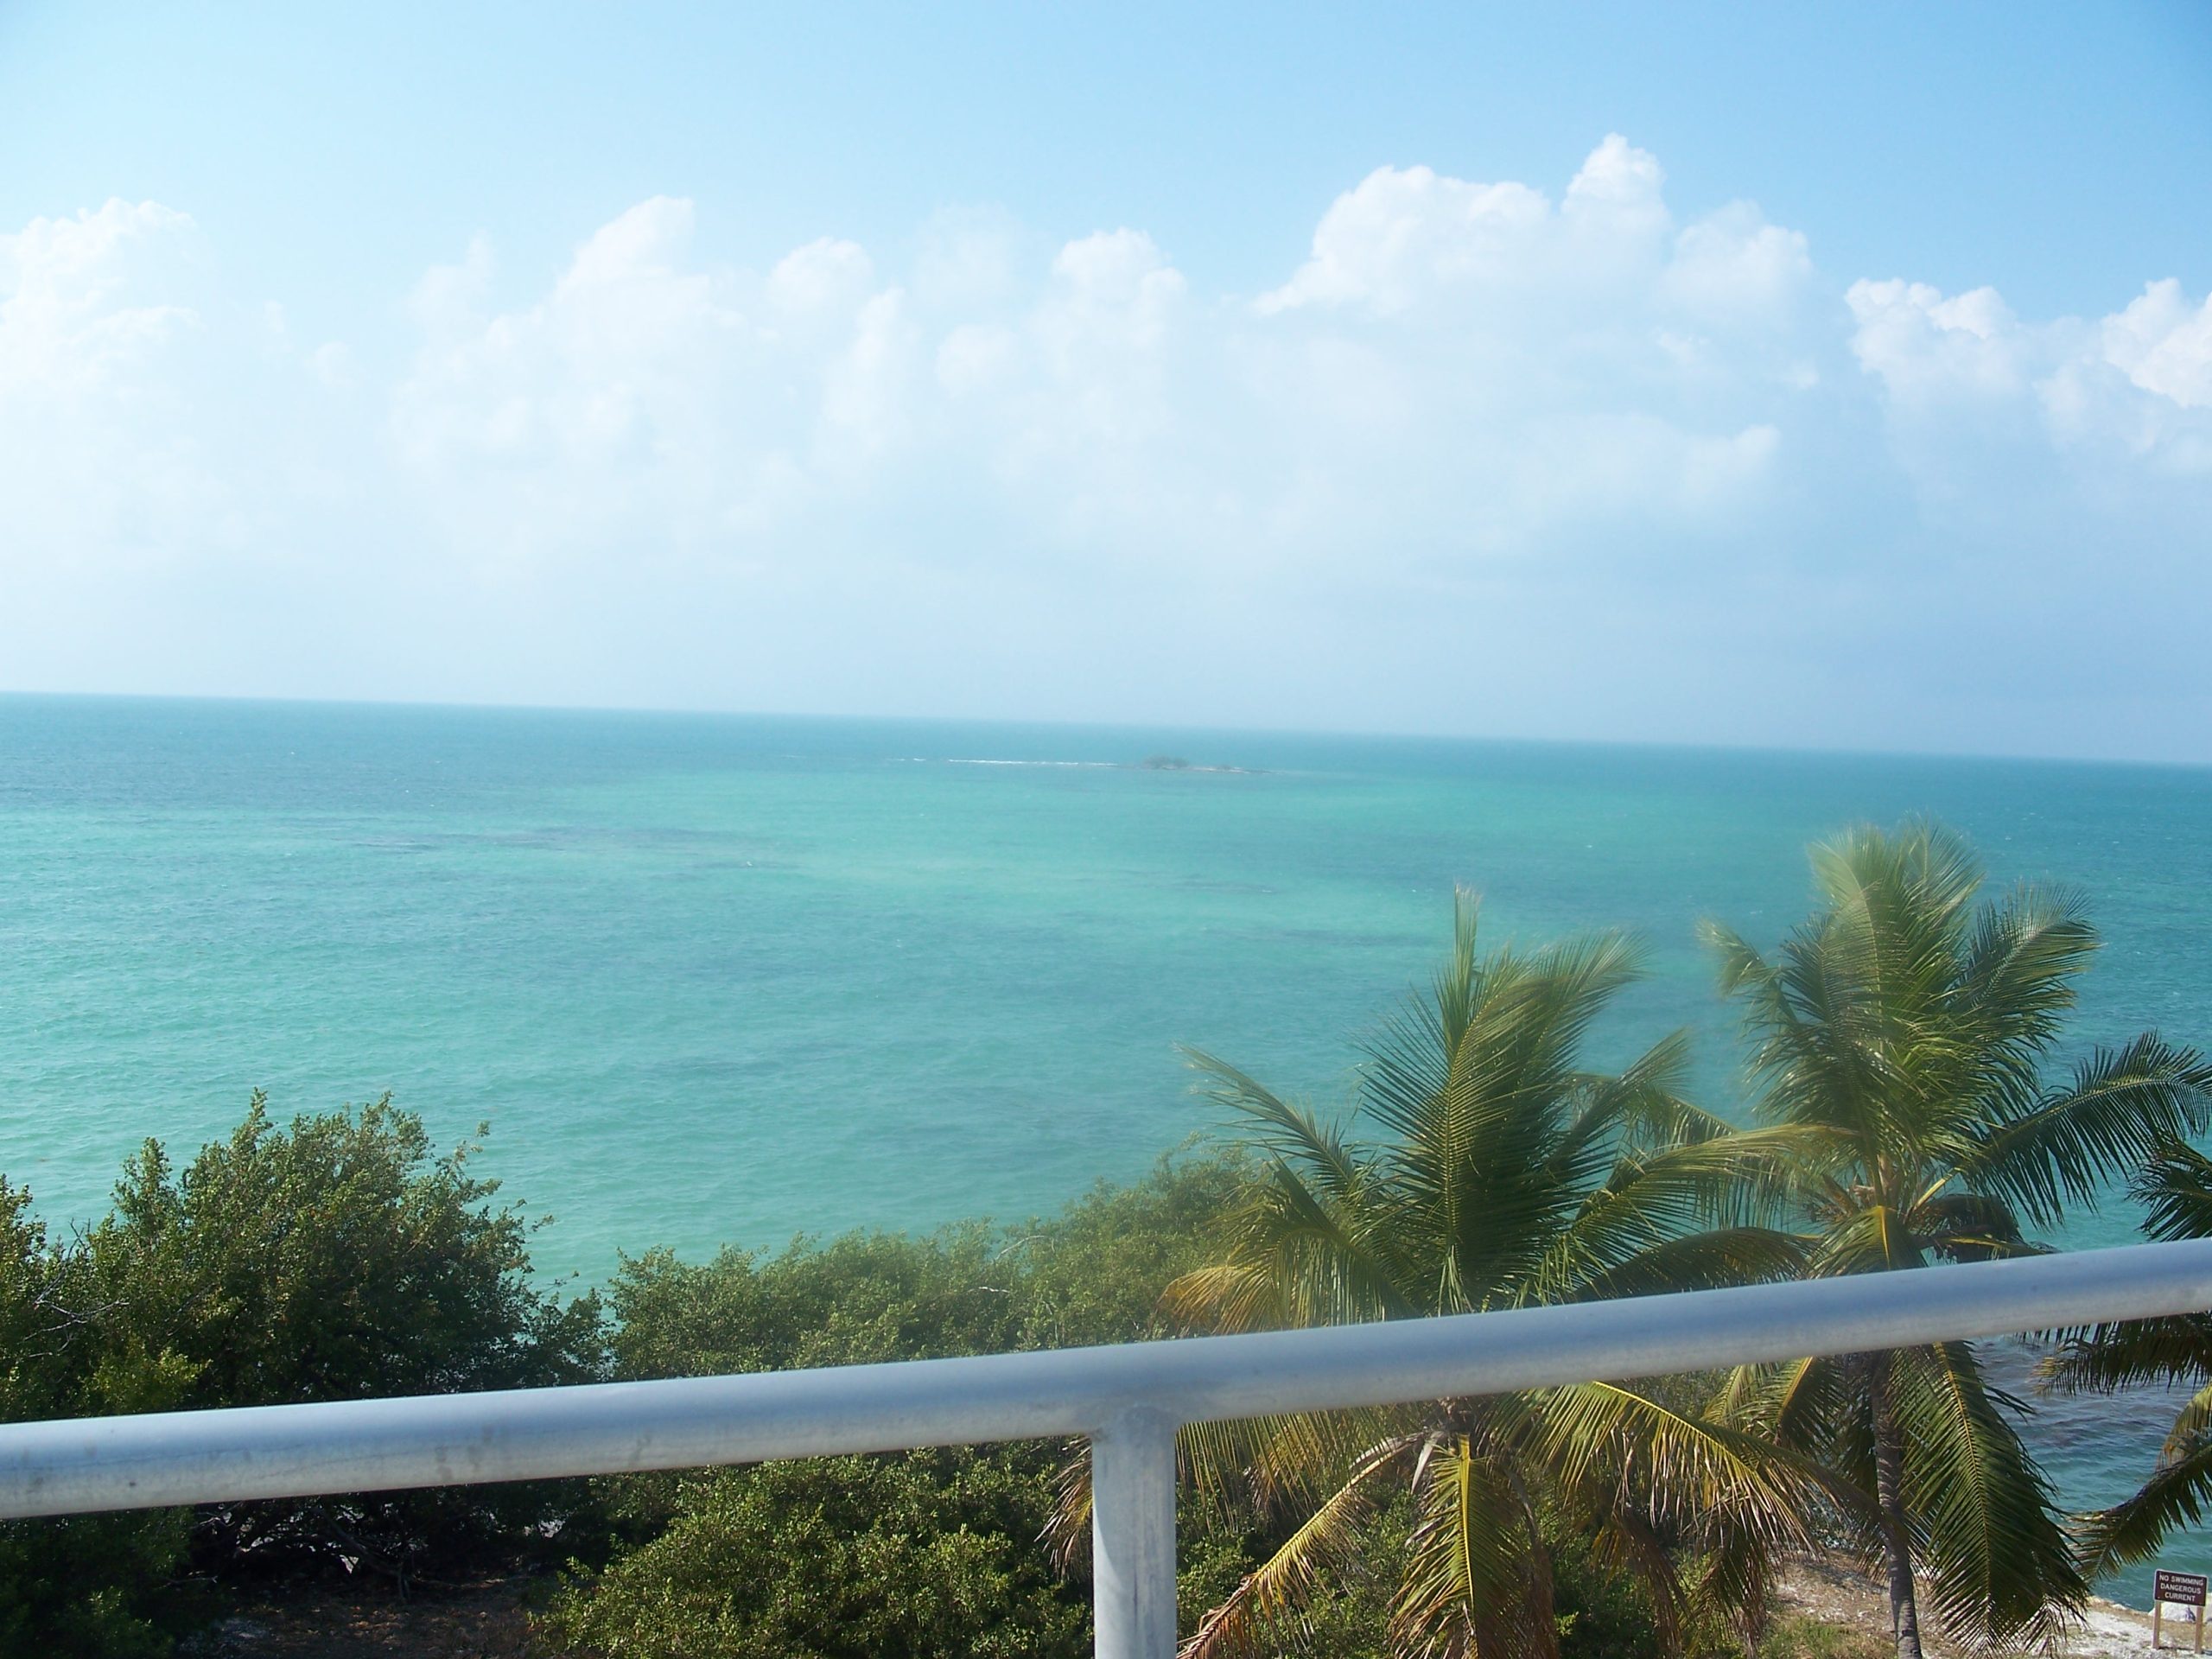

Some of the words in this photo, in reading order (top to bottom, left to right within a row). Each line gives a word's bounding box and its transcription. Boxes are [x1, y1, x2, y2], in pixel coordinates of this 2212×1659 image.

[2171, 1576, 2203, 1586] SWIMMING
[2160, 1583, 2201, 1594] DANGEROUS
[2164, 1592, 2196, 1601] CURRENT
